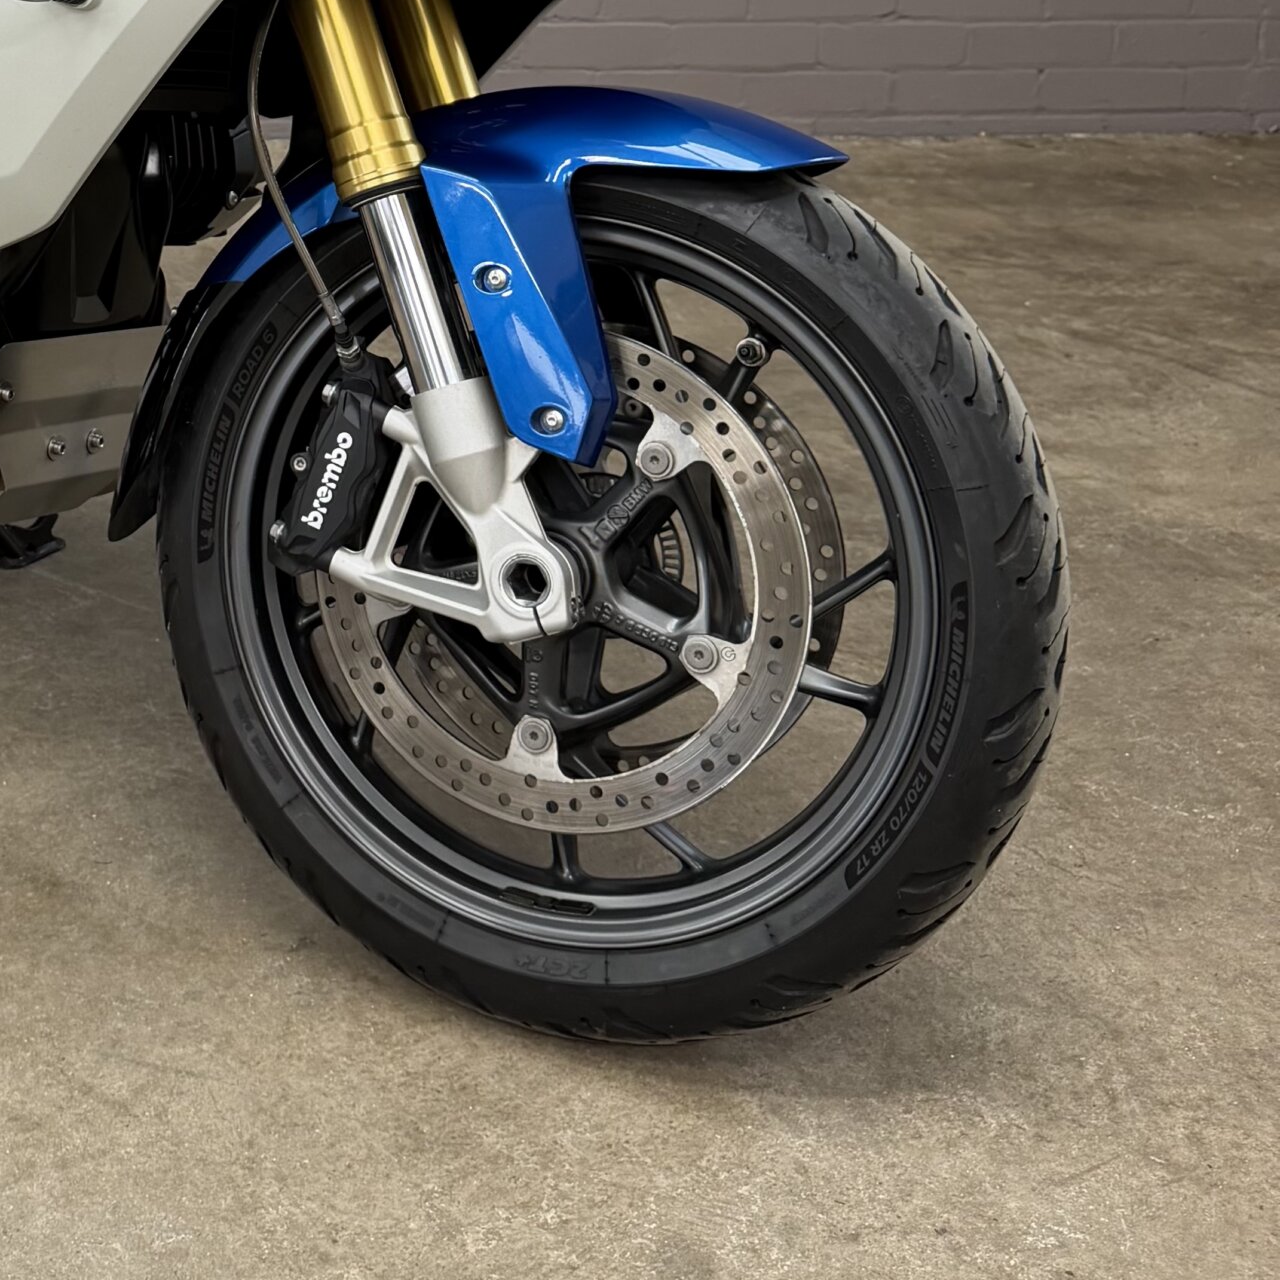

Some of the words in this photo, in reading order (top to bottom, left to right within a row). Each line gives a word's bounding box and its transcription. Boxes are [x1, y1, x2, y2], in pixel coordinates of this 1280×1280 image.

[200, 414, 231, 521] MICHELIN
[231, 345, 263, 398] ROAD
[262, 329, 274, 343] 6
[300, 431, 353, 530] brembo
[621, 477, 653, 511] BMW
[929, 626, 964, 753] MICHELIN
[889, 771, 927, 830] 120/70
[856, 854, 870, 875] 17
[869, 829, 889, 856] ZR
